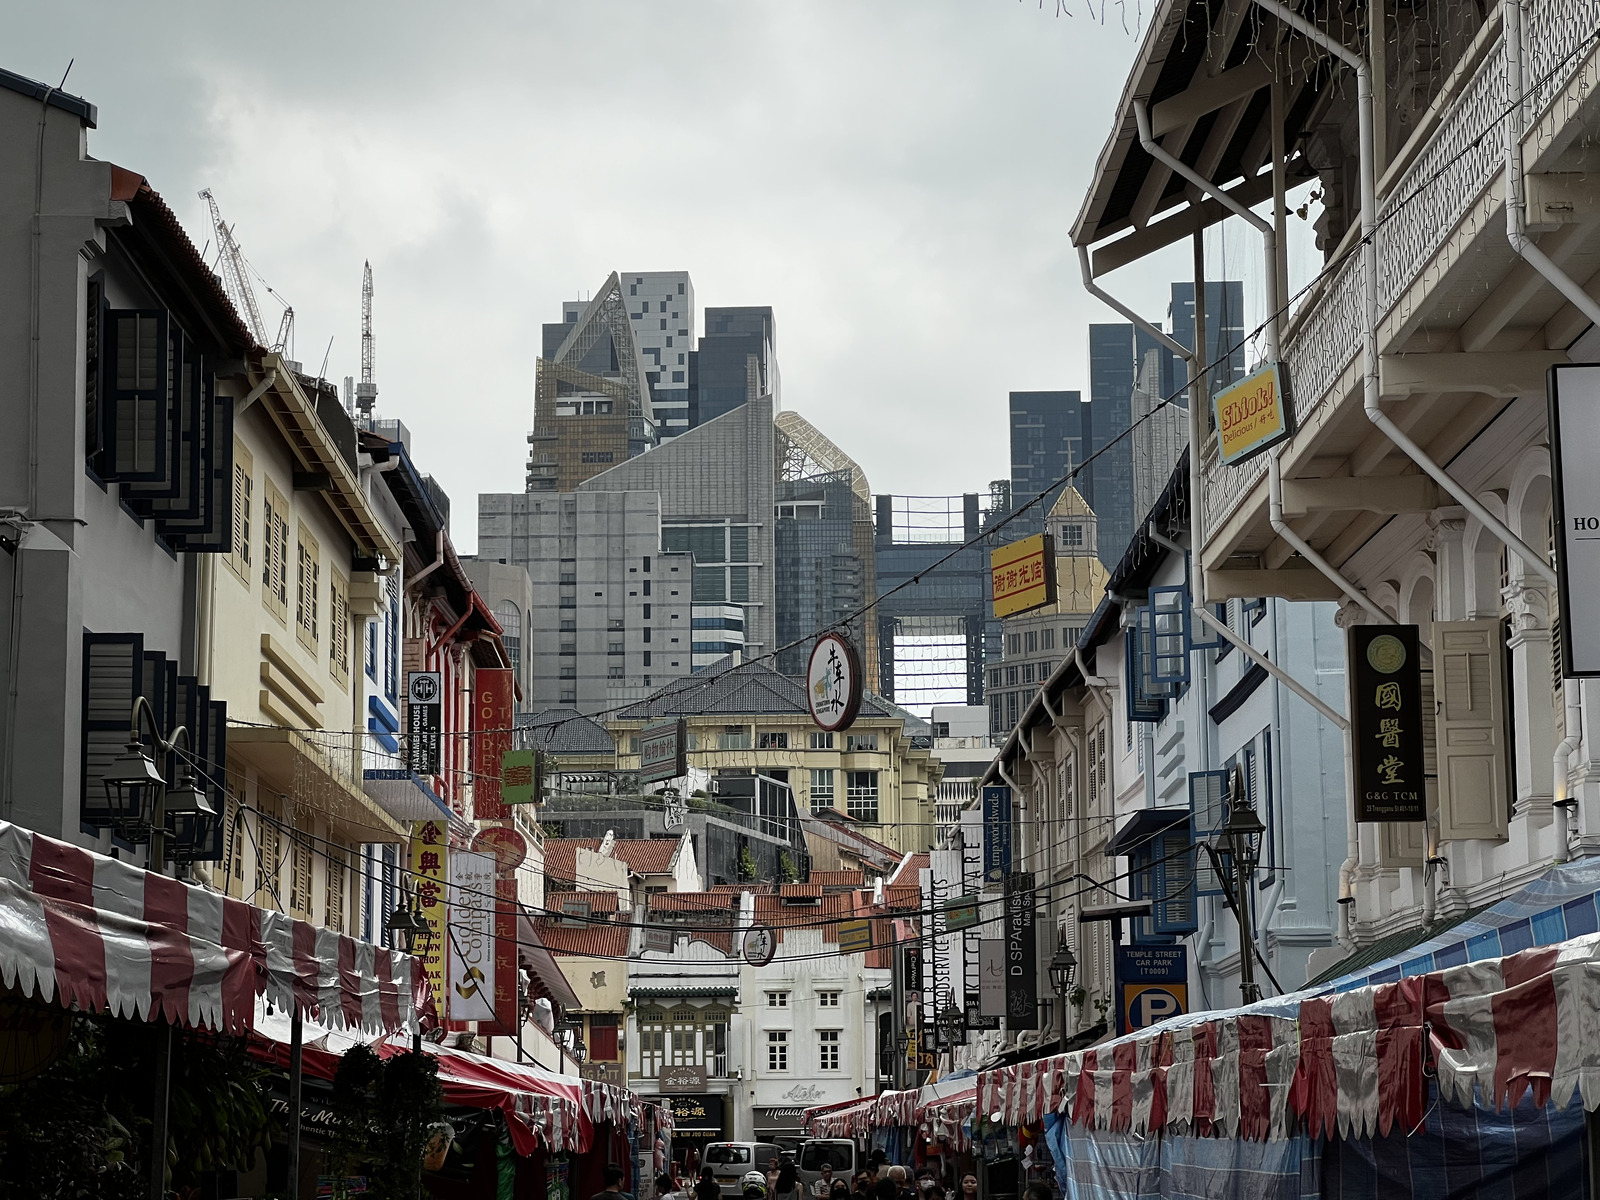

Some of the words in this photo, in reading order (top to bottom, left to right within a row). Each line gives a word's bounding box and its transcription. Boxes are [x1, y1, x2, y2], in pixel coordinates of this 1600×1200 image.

[1222, 382, 1273, 431] Shiok!
[1224, 422, 1253, 445] Delicious
[1375, 682, 1405, 785] 國醫堂
[1366, 791, 1389, 800] G&G
[1393, 791, 1418, 800] TCM
[453, 884, 471, 957] Golden
[465, 882, 486, 964] Compass
[964, 842, 981, 991] KITCHWARE
[1010, 965, 1023, 976] D
[1140, 967, 1169, 976] (T0009)
[1140, 993, 1177, 1027] P
[270, 1098, 310, 1118] Thi
[672, 1107, 706, 1117] 裕源
